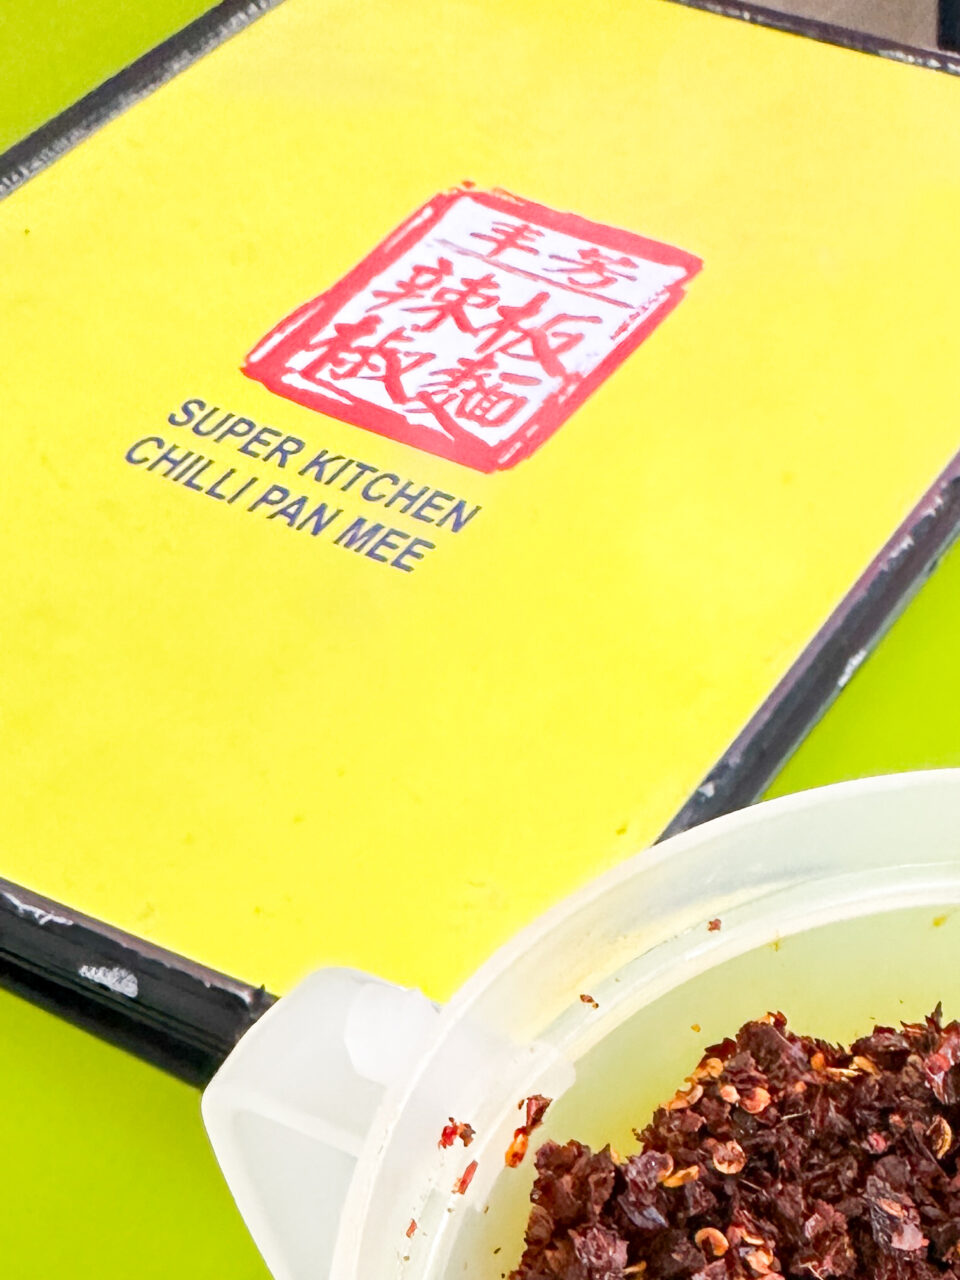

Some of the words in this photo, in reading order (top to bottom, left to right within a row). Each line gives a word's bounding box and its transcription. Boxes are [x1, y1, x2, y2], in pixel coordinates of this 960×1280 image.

[469, 220, 639, 289] 丰芳
[125, 436, 259, 504] CHILLI
[247, 484, 344, 536] PAN
[333, 516, 436, 572] MEE
[167, 398, 305, 468] SUPER
[298, 449, 482, 533] KITCHEN
